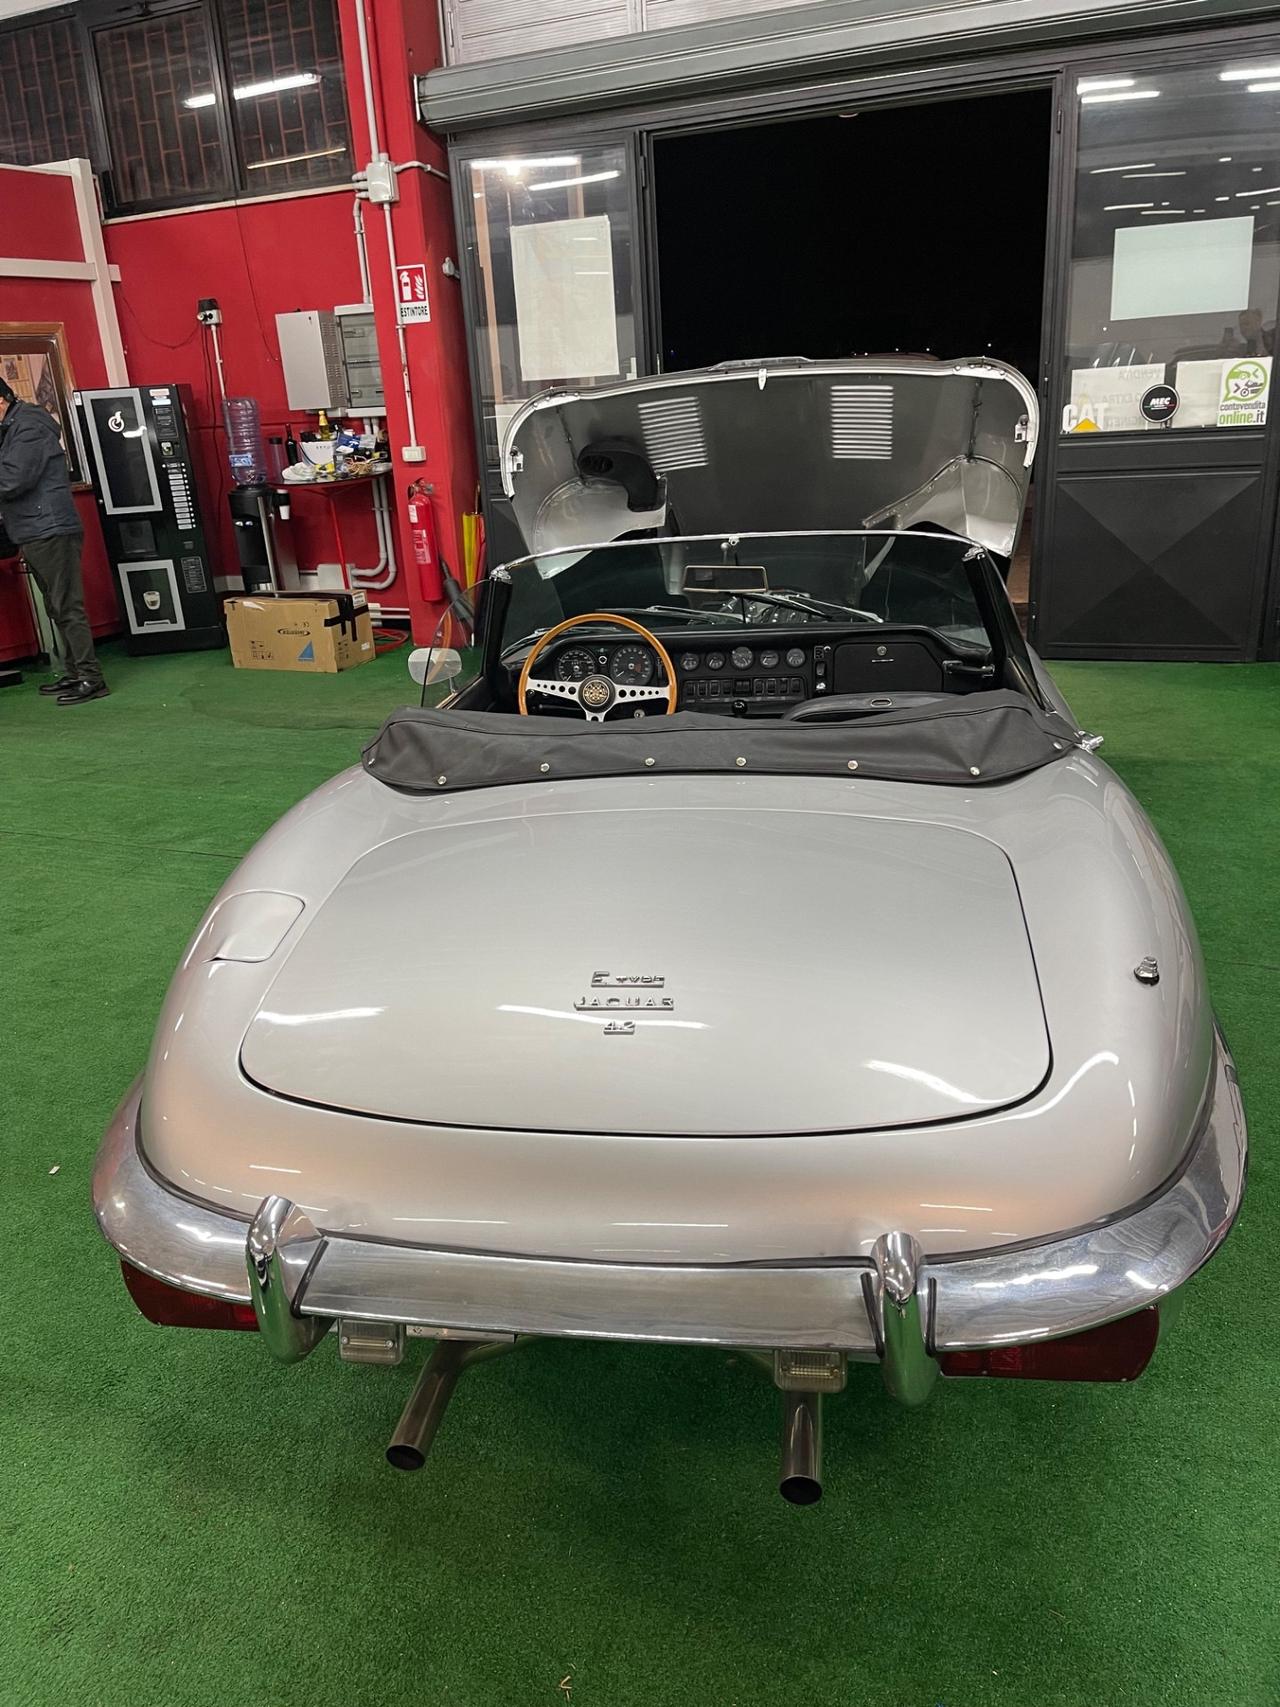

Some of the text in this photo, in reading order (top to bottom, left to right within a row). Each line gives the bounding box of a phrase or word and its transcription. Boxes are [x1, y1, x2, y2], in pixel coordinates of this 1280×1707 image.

[400, 305, 428, 318] ESTINTORE
[1150, 397, 1171, 406] MEC
[1062, 402, 1109, 431] CAT
[1219, 409, 1265, 425] online.it
[574, 996, 674, 1010] JAGUAR
